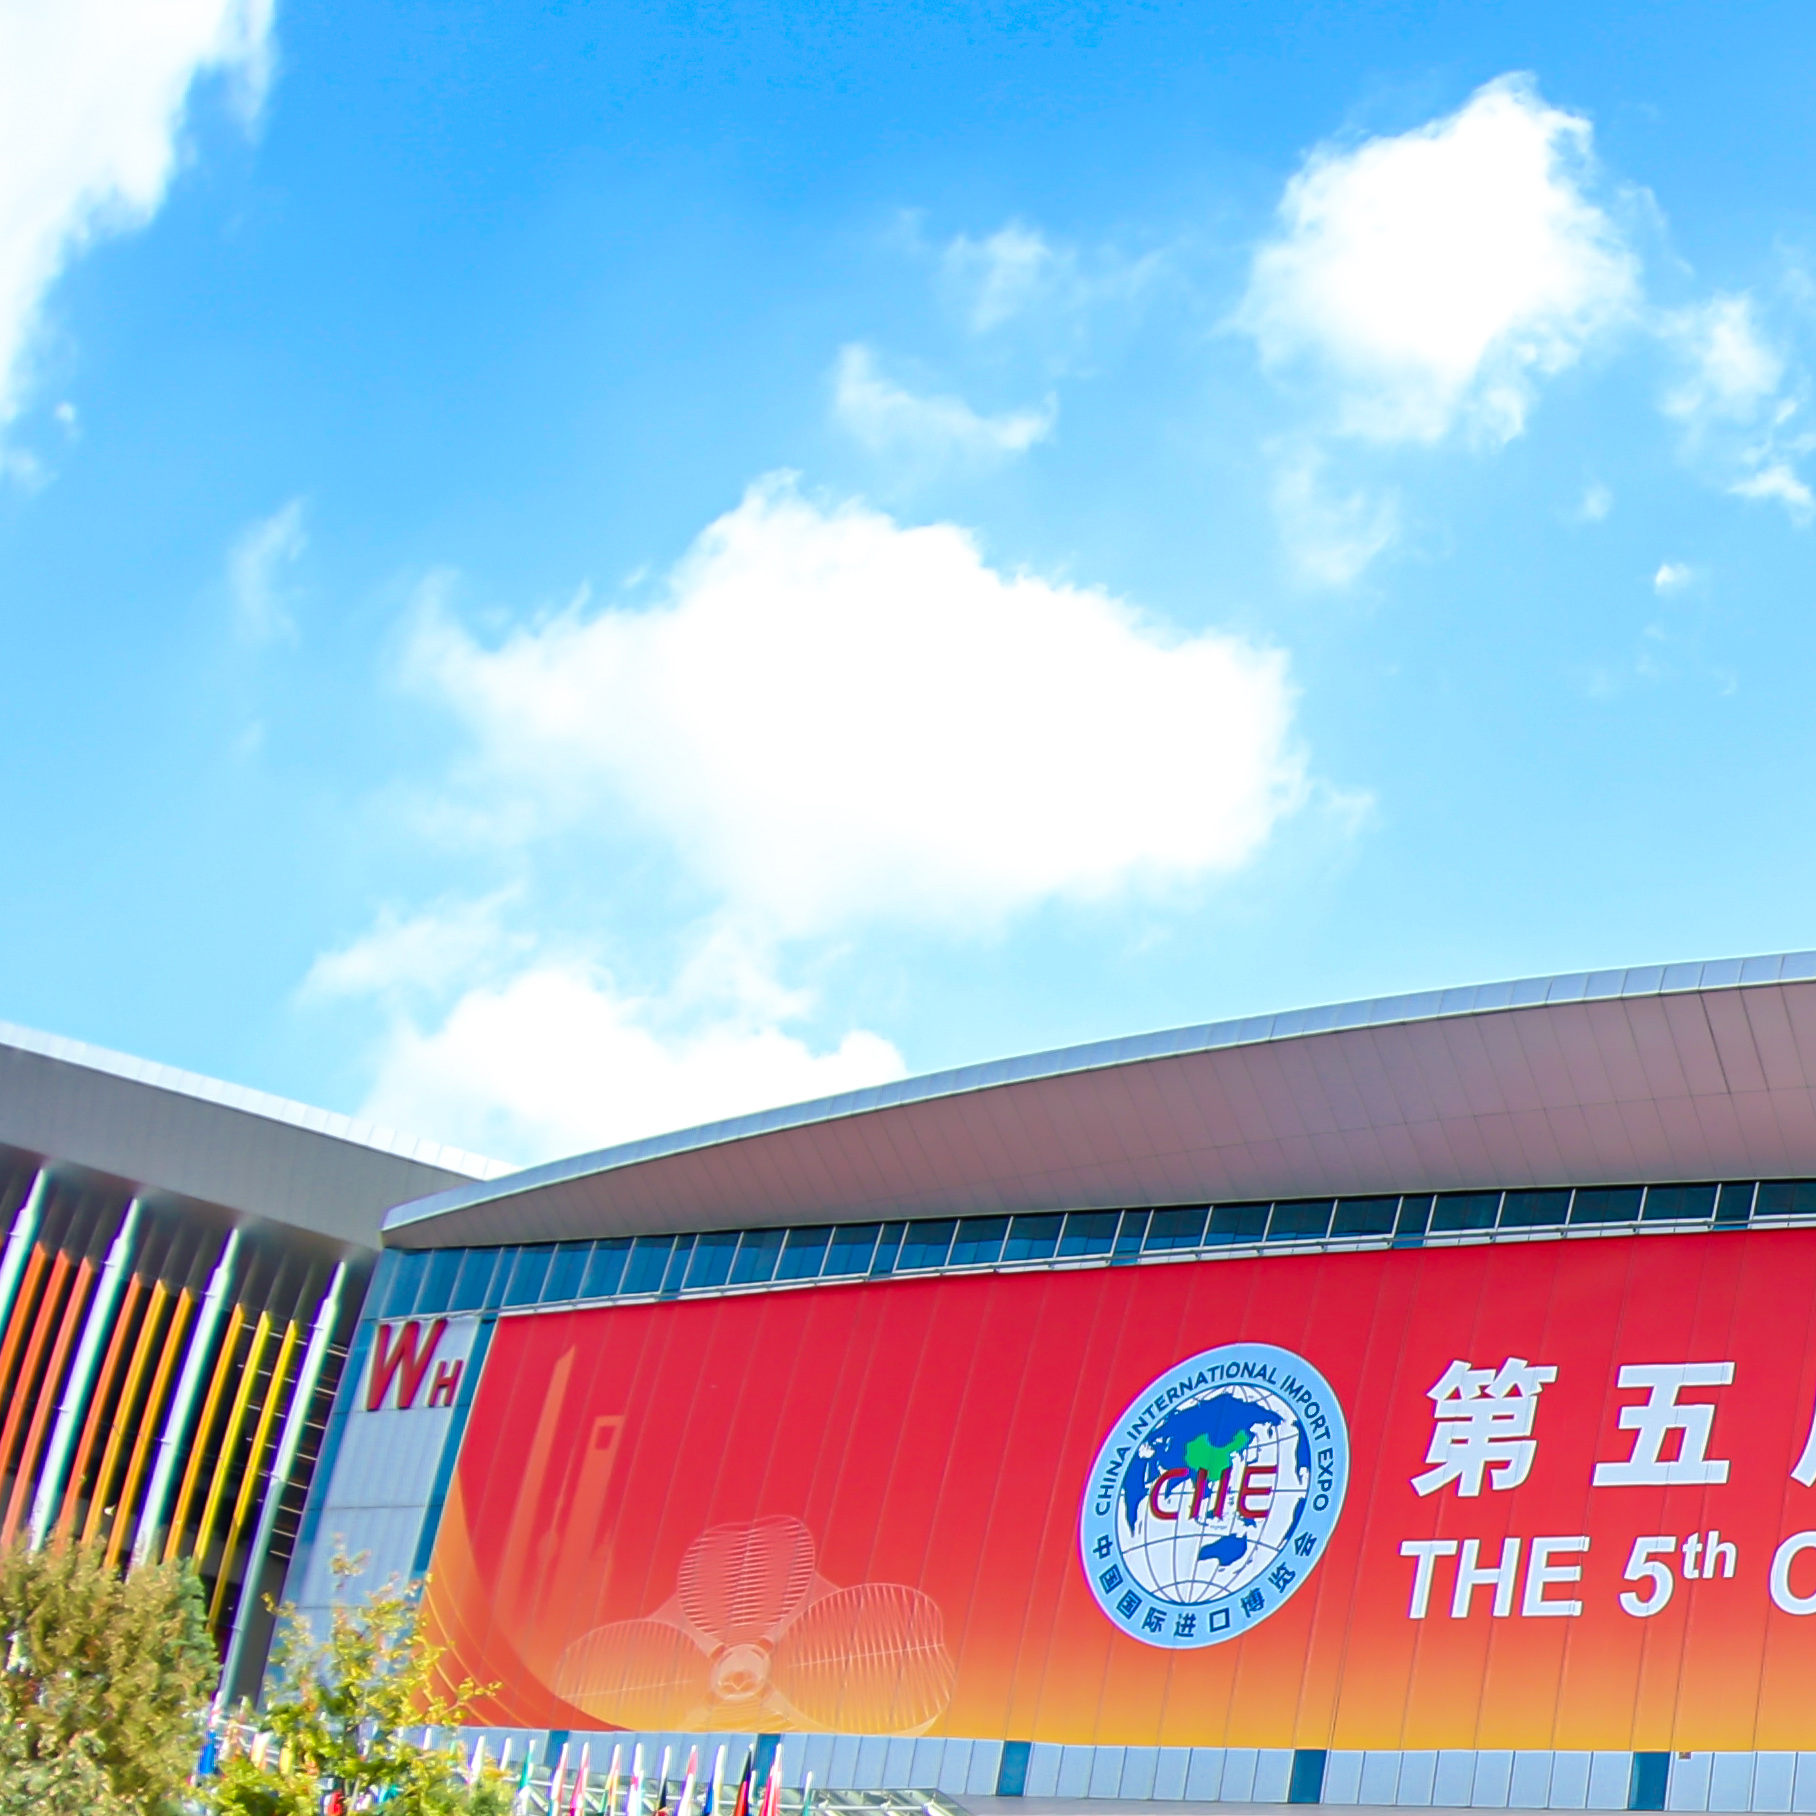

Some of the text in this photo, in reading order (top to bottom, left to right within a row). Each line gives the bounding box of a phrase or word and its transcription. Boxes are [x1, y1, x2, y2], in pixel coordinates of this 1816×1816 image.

[1095, 1361, 1334, 1517] CHINA INTERNATIONAL IMPORT EXPO
[1149, 1465, 1278, 1522] CIIE
[1092, 1531, 1319, 1639] 中国国际进口博览会
[1399, 1535, 1590, 1619] THE
[1619, 1530, 1738, 1619] 5th
